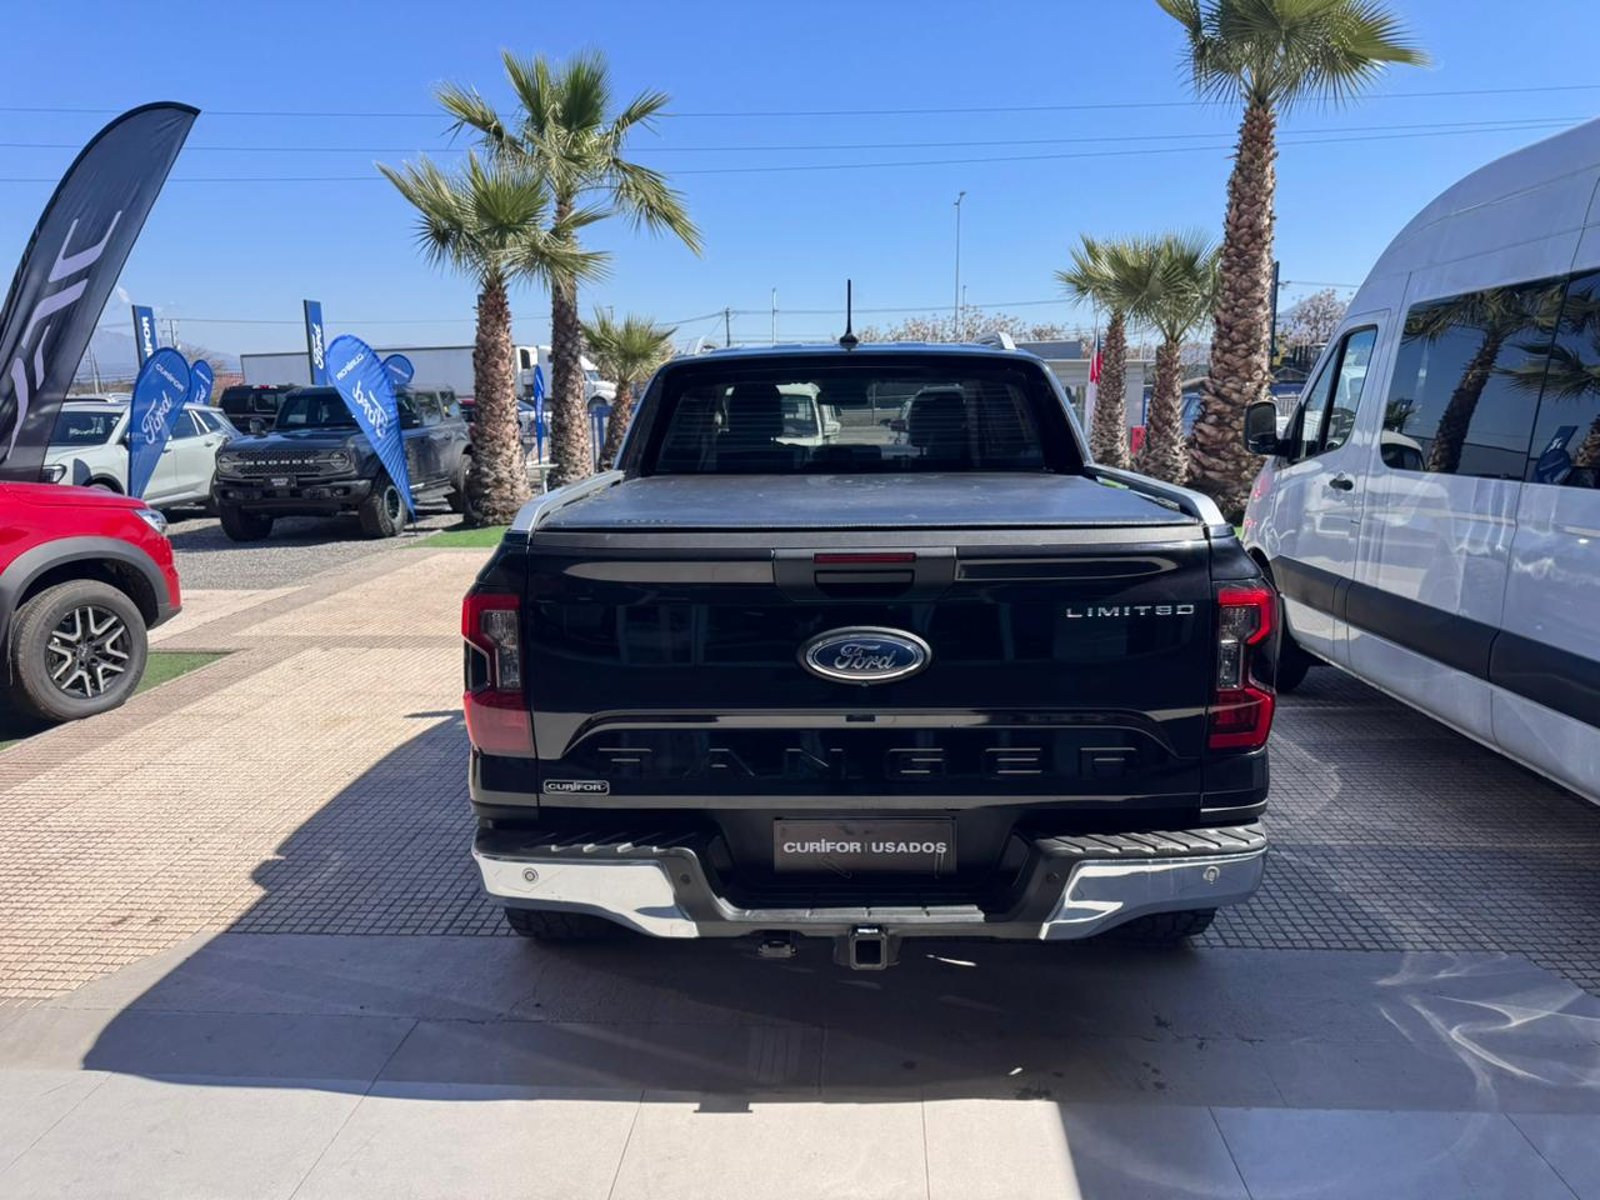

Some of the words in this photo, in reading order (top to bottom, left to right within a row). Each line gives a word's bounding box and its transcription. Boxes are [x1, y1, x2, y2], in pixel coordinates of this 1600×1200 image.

[141, 390, 172, 444] Ford
[1066, 604, 1194, 618] LIMITED
[834, 643, 896, 670] Ford
[871, 842, 947, 853] USADOS
